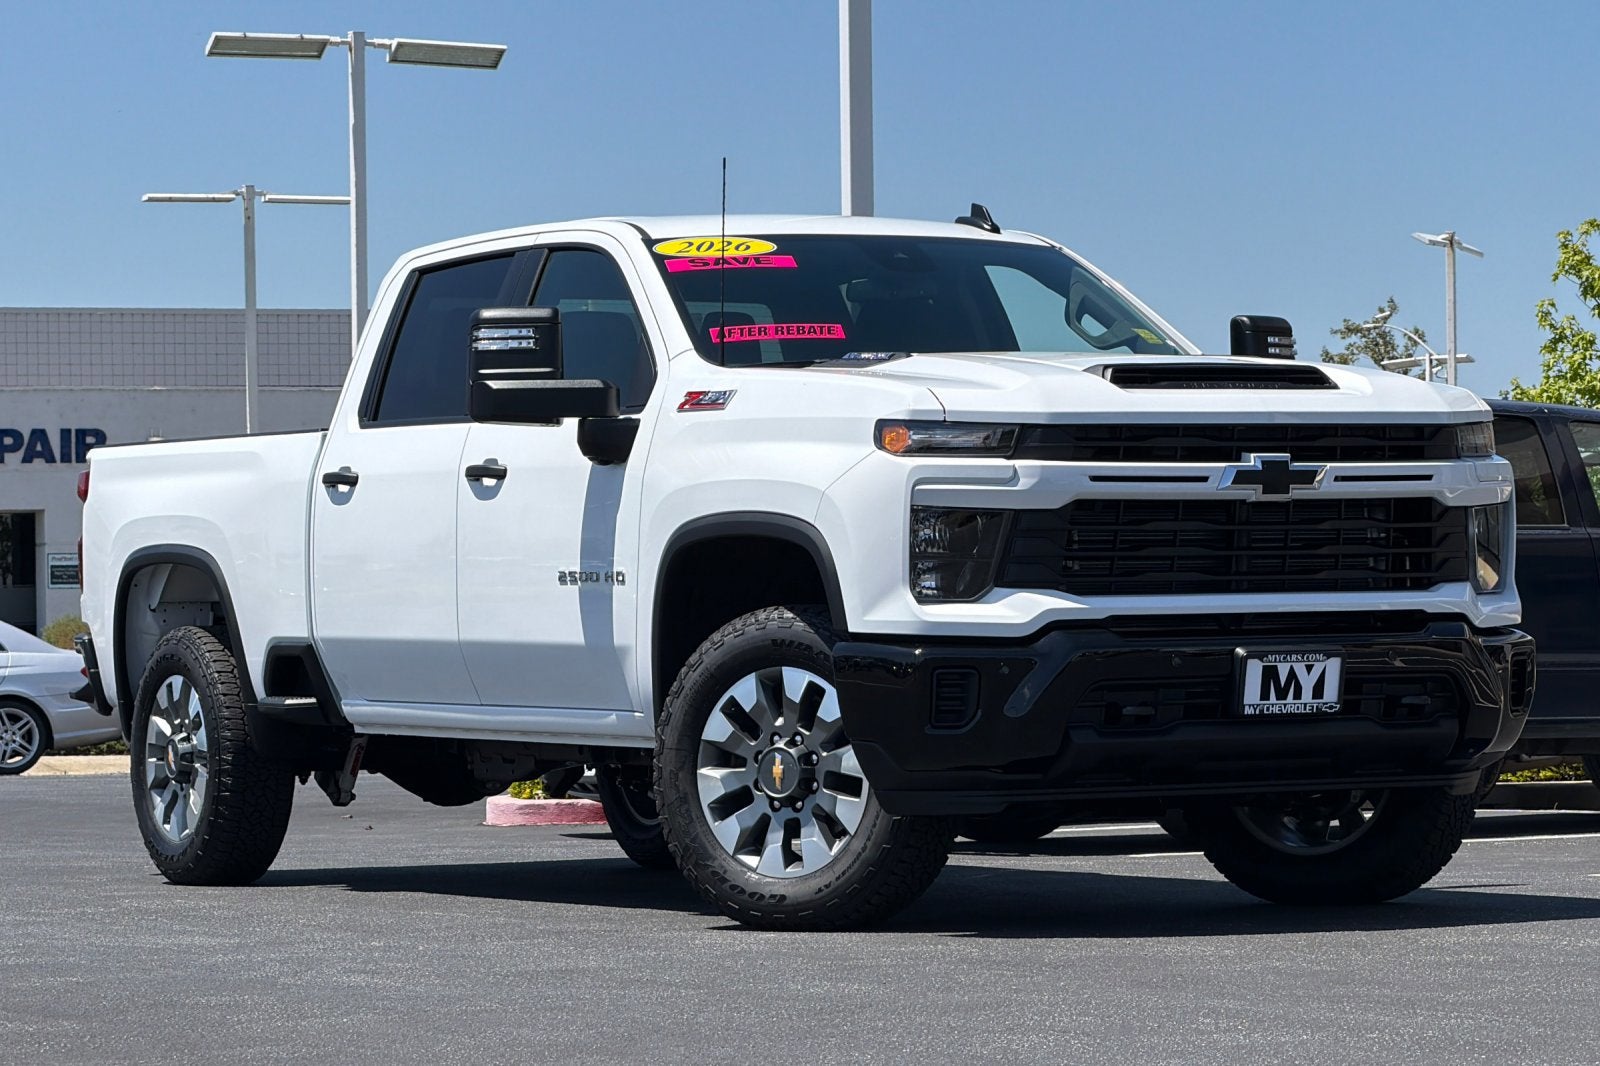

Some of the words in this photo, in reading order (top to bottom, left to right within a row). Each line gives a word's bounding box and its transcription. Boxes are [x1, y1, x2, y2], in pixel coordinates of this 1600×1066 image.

[675, 240, 753, 254] 2026
[687, 256, 776, 268] SAVE
[716, 326, 769, 340] AFTER
[774, 325, 837, 336] REBATE
[558, 571, 600, 583] 2500
[604, 571, 625, 584] HD
[1263, 703, 1319, 714] CHEVROLET
